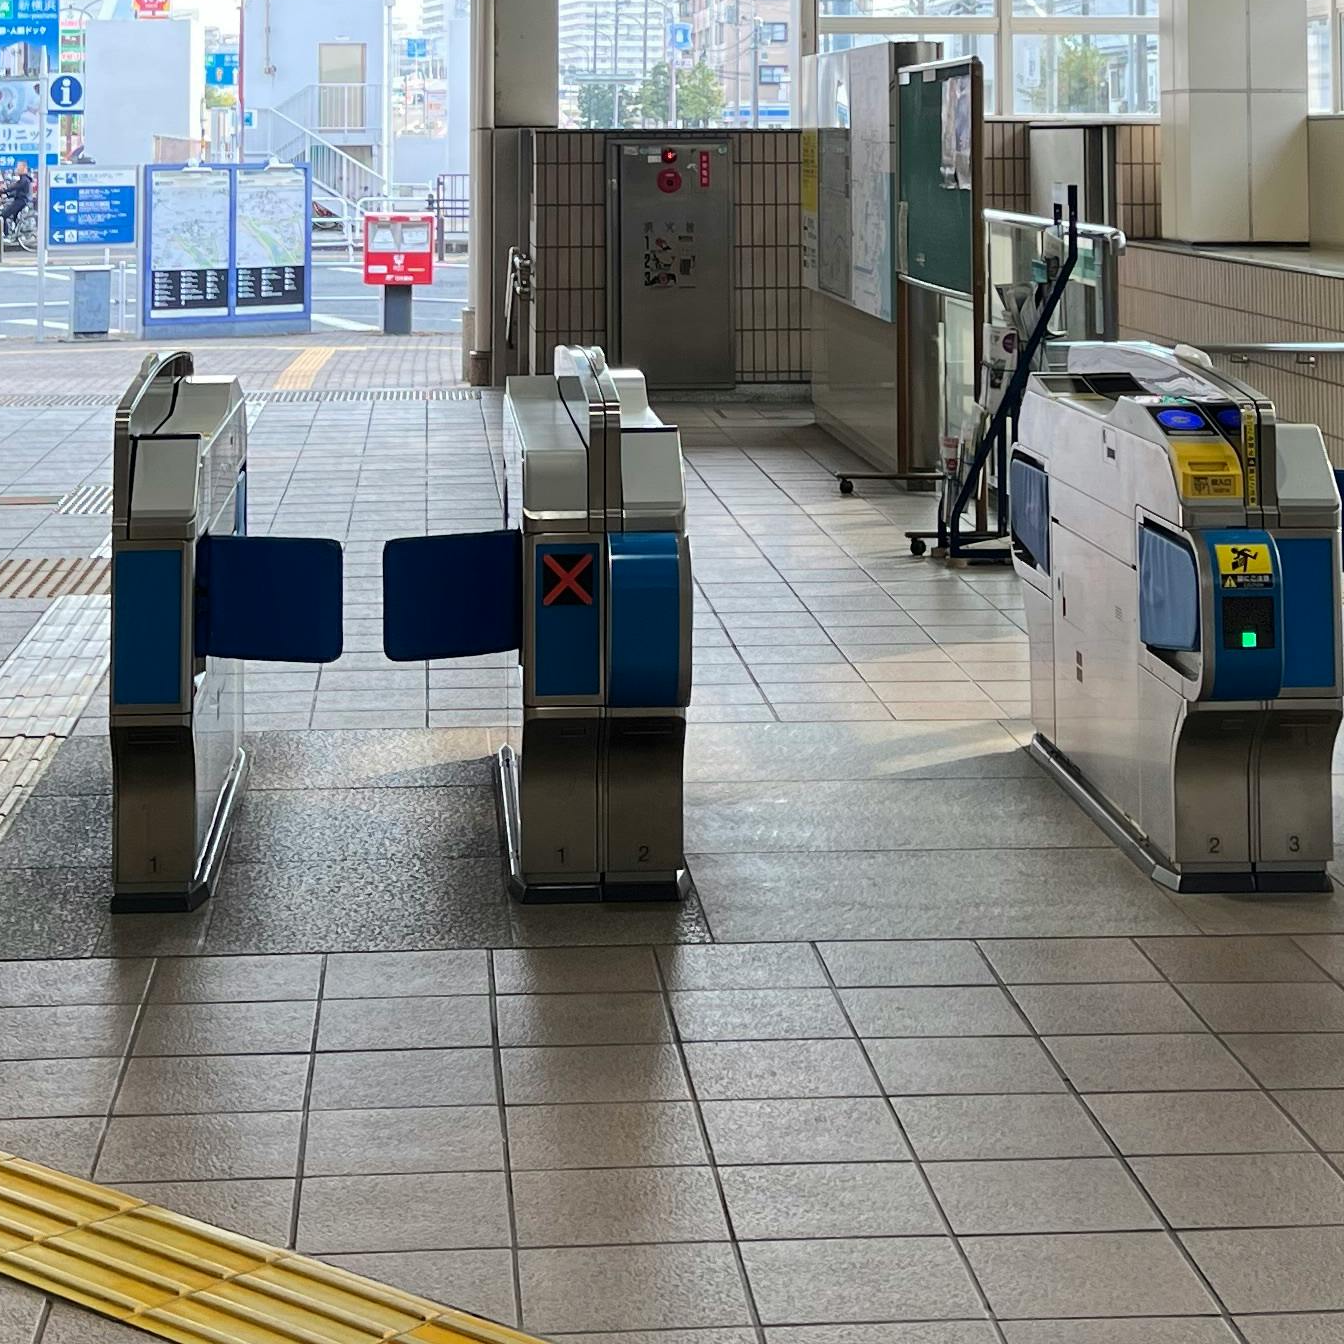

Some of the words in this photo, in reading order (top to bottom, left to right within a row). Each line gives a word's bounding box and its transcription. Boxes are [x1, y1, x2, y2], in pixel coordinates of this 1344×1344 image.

[17, 0, 57, 12] 新横浜
[1209, 837, 1220, 854] 2
[1289, 835, 1300, 852] 3
[557, 848, 565, 865] 1
[638, 845, 649, 862] 2
[148, 856, 157, 873] 1
